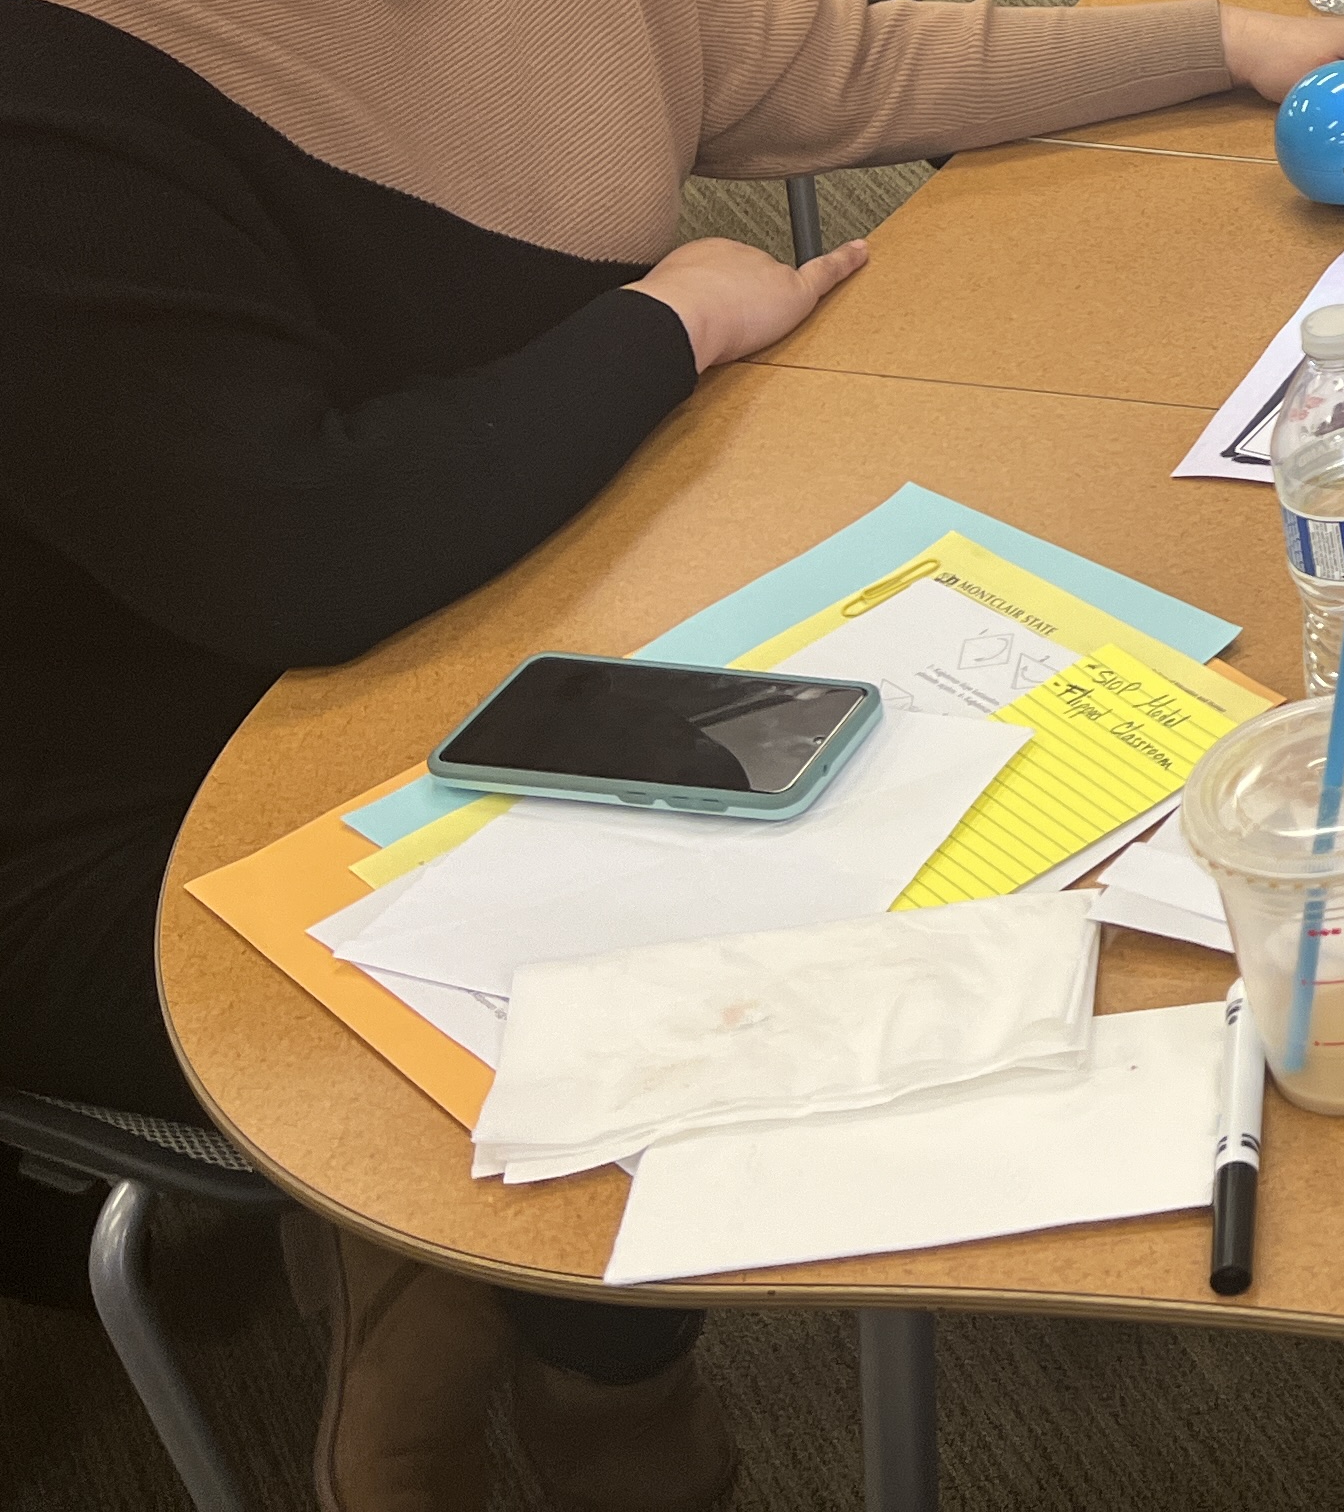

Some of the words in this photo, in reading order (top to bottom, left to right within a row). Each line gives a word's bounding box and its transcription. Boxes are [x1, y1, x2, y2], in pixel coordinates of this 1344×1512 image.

[959, 581, 1024, 623] MONTCLAIR
[1019, 615, 1058, 636] STATE
[1133, 694, 1192, 728] Model
[1110, 721, 1174, 771] Classroom
